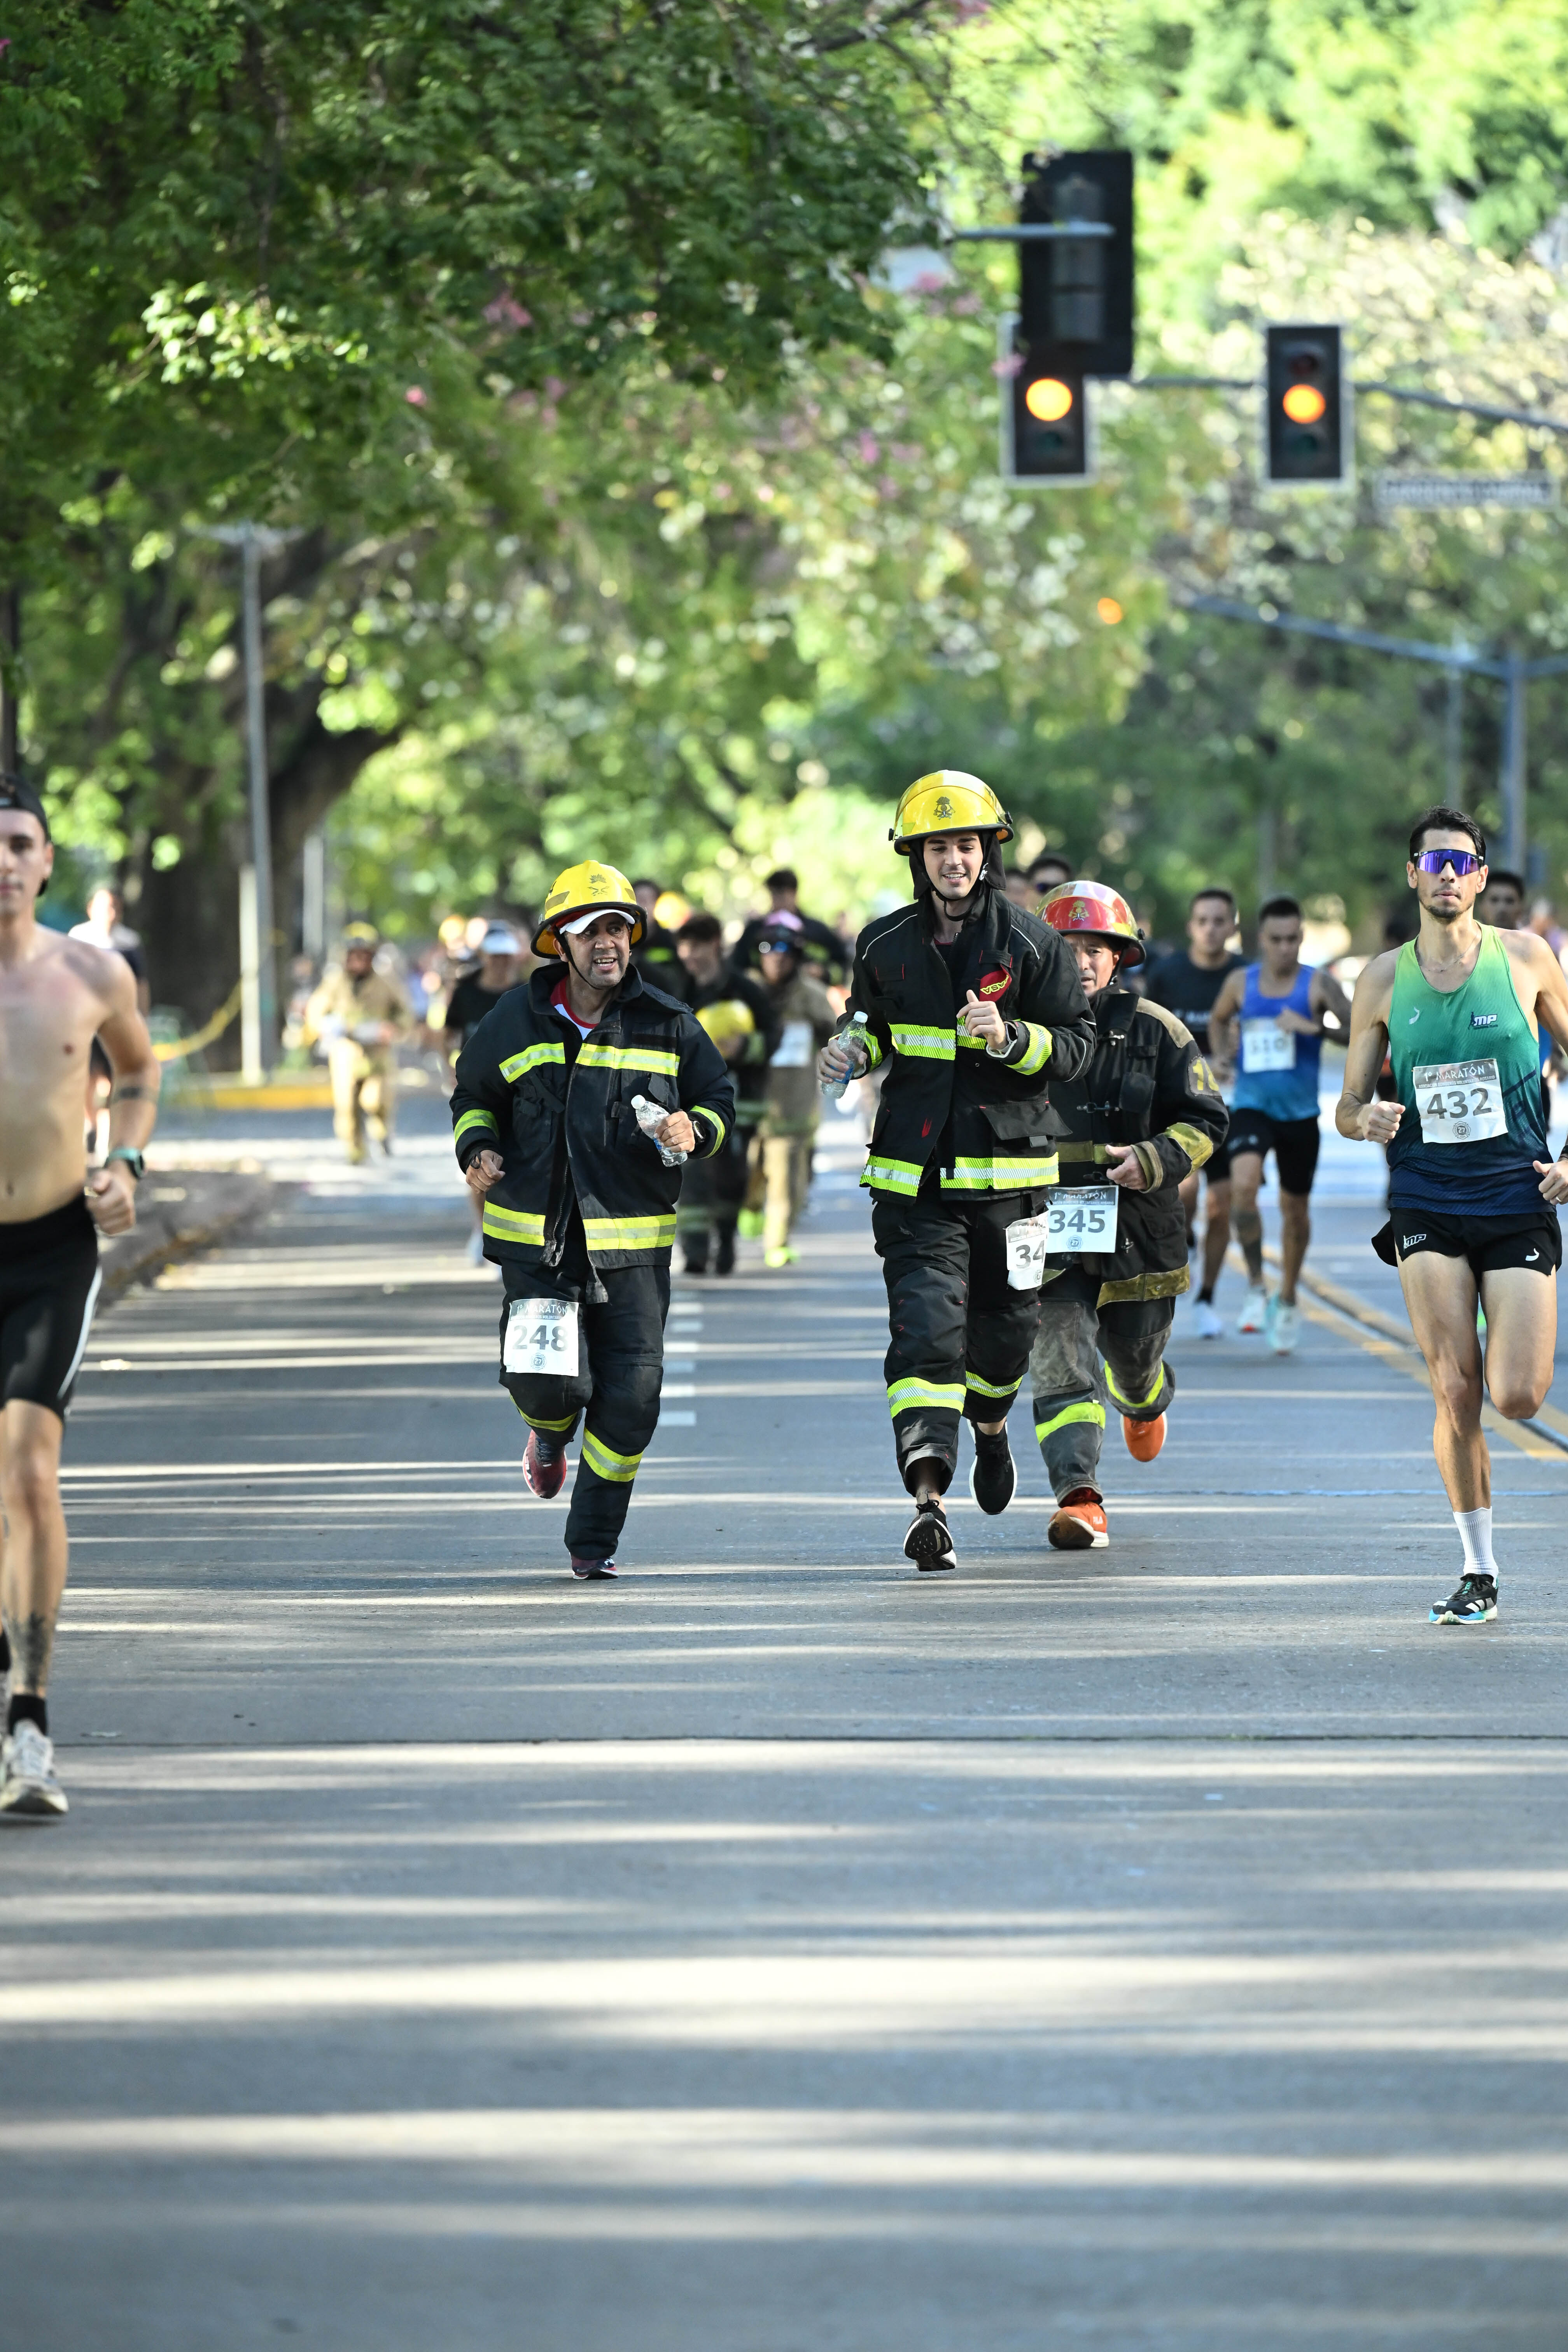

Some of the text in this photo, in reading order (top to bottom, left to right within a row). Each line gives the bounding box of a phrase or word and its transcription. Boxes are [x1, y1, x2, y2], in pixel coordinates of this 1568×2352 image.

[1474, 1014, 1497, 1027] MP
[1436, 1064, 1485, 1080] MARATÓN
[1427, 1088, 1492, 1119] 432
[1063, 1190, 1106, 1200] MARATÓN
[1049, 1210, 1105, 1233] 345
[513, 1325, 568, 1351] 248
[1093, 1516, 1103, 1524] FILA
